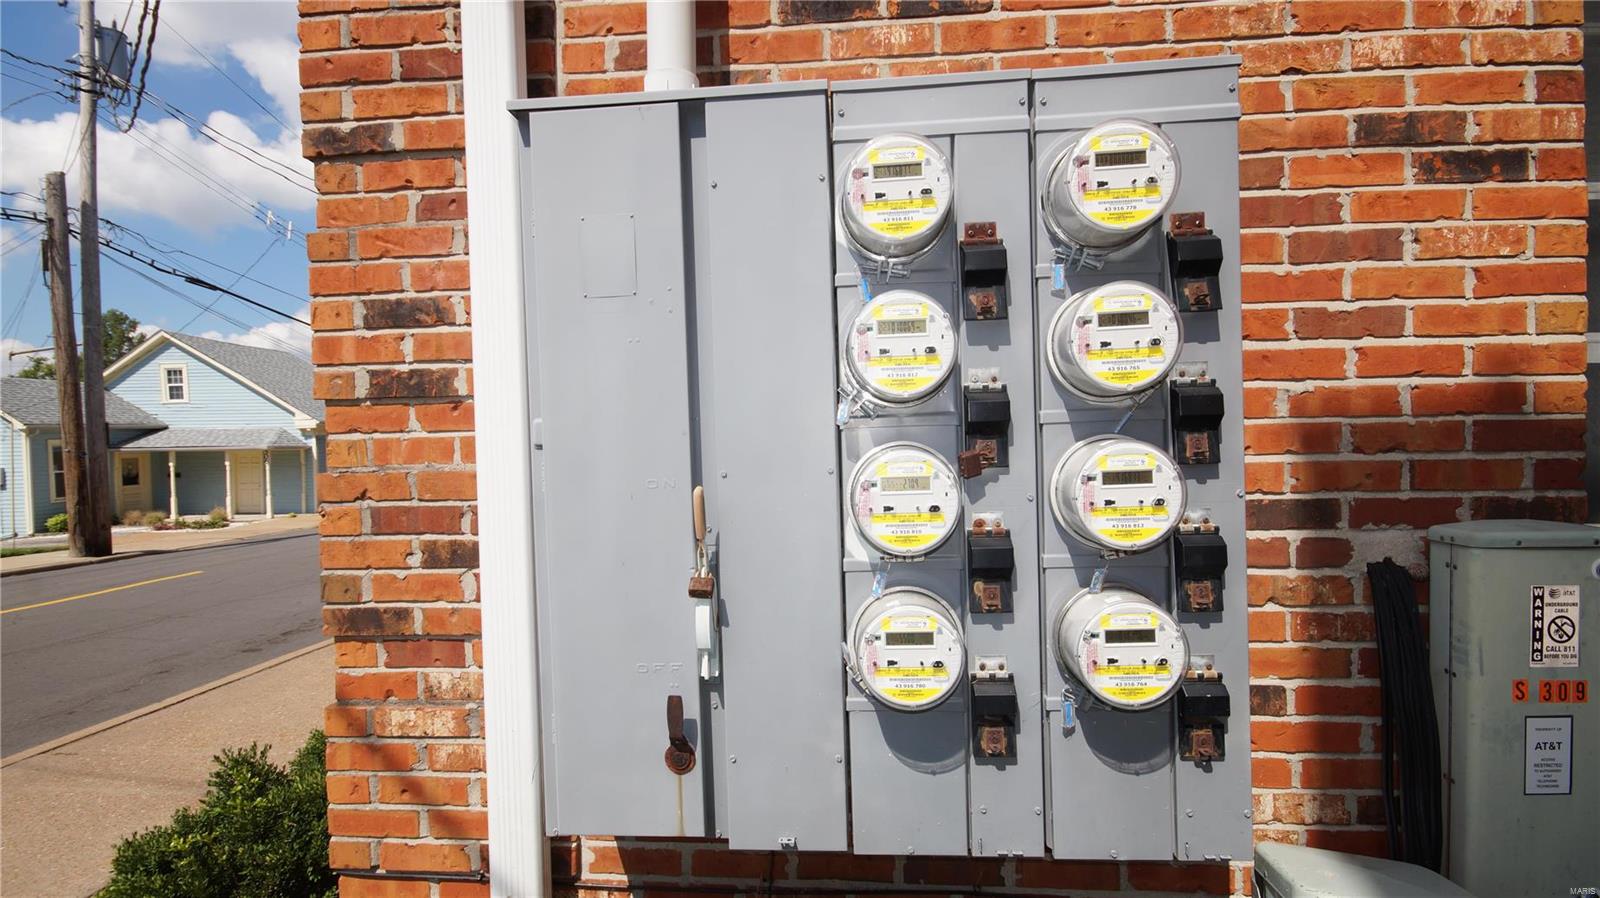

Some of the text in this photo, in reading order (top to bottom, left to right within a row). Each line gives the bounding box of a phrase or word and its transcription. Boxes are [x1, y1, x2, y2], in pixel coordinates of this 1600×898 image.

[646, 478, 678, 490] ON
[1533, 588, 1544, 661] WARNING
[636, 662, 684, 674] OFF
[1515, 681, 1585, 701] S 309
[1534, 741, 1563, 751] AT&T
